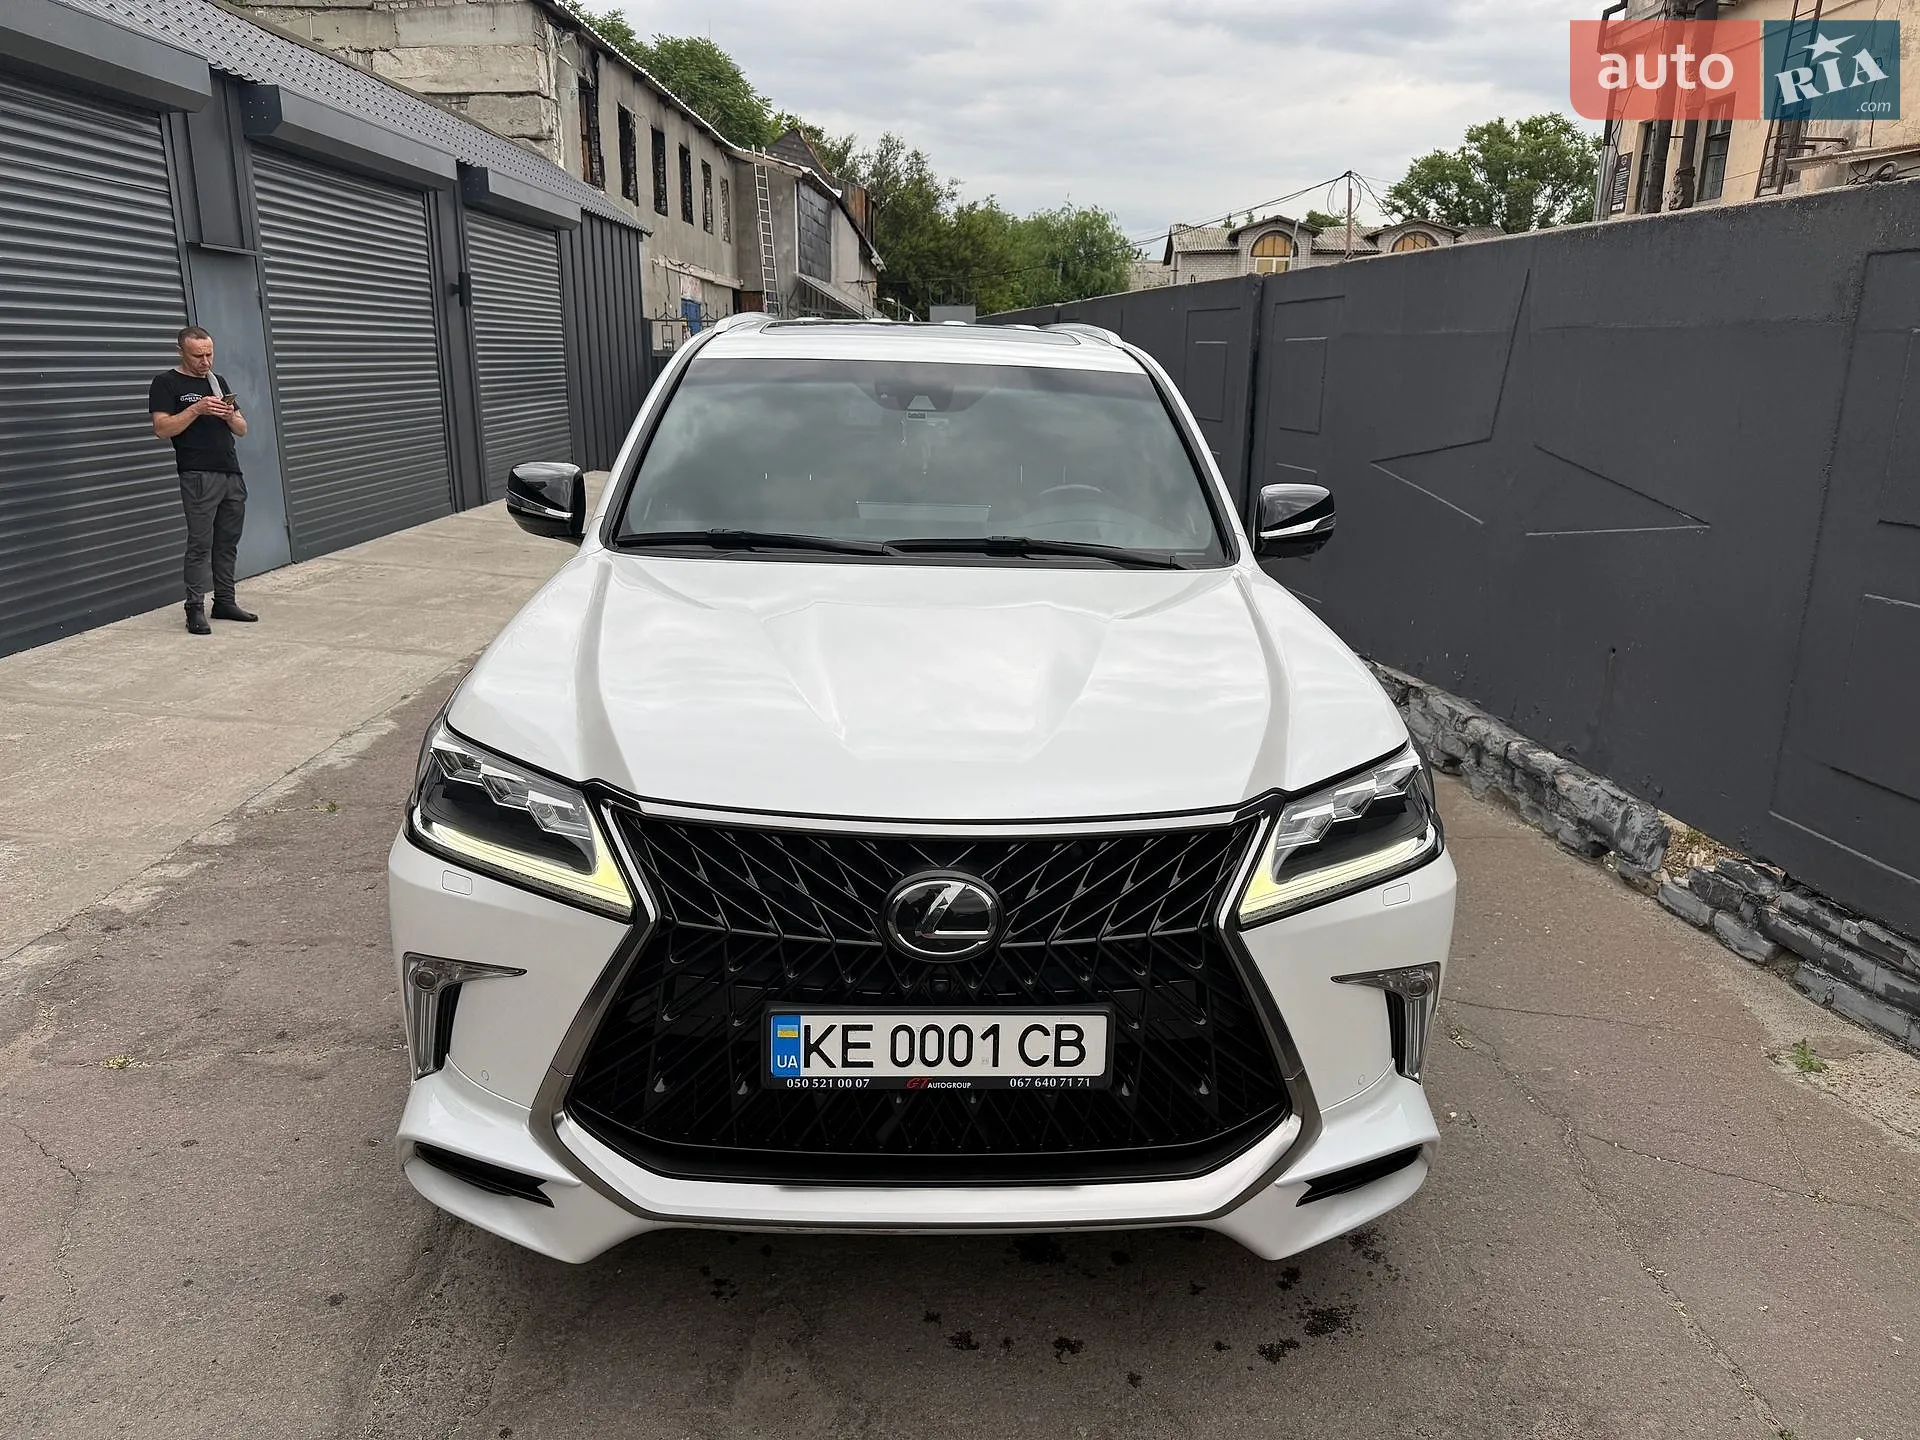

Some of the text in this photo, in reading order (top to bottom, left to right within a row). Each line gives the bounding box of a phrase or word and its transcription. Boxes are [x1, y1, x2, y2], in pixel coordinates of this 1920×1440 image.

[804, 1024, 1086, 1068] KE 0001 CB
[777, 1055, 798, 1068] UA
[786, 1079, 870, 1088] 050 521 00 07
[906, 1077, 931, 1089] GT
[1009, 1078, 1091, 1088] 067 640 71 71
